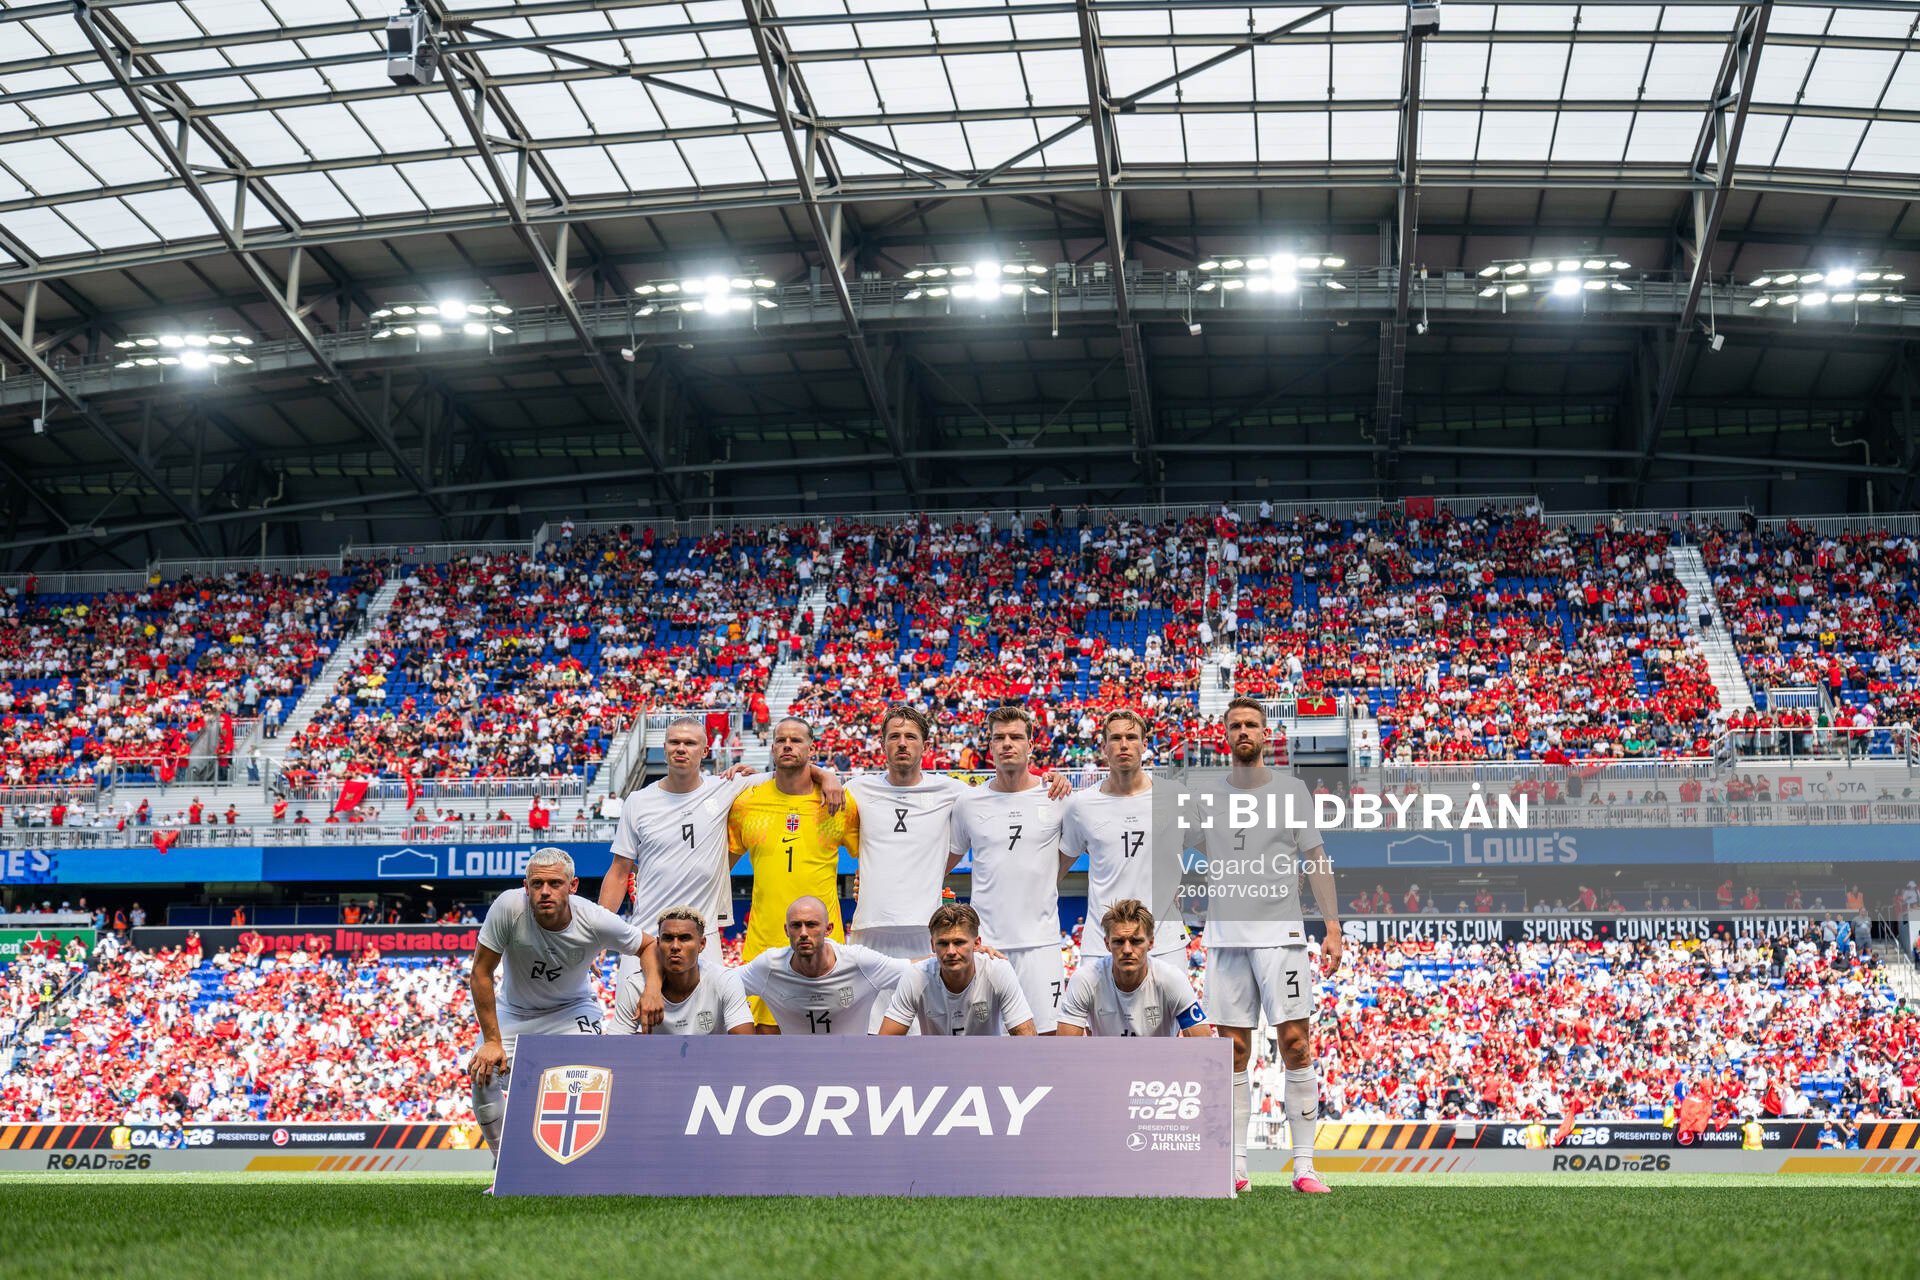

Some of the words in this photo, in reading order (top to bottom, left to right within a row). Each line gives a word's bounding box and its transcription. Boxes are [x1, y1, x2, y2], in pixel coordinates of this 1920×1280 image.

[1808, 782, 1867, 793] TOOTA
[893, 808, 908, 832] 8
[682, 823, 695, 849] 9
[1008, 824, 1023, 850] 7
[1121, 831, 1145, 858] 17
[0, 850, 50, 880] ES
[448, 846, 537, 876] LOWE'
[785, 846, 793, 872] 1
[335, 929, 477, 950] Illustrated
[1523, 918, 1593, 941] SPORTS
[1616, 917, 1710, 940] CONCERTS
[0, 943, 20, 954] en
[530, 960, 563, 982] 26
[1050, 981, 1062, 1008] 7
[1285, 970, 1300, 998] 3
[805, 1010, 832, 1033] 14
[1189, 1004, 1203, 1022] C
[566, 1070, 589, 1078] NORGE
[1128, 1081, 1201, 1097] ROAD
[684, 1084, 1053, 1136] NORWAY
[1128, 1106, 1155, 1119] TO
[217, 1133, 259, 1141] PRESENTED
[260, 1133, 270, 1141] BY
[291, 1132, 327, 1142] TURKISH
[328, 1132, 366, 1142] AIRLINES
[1151, 1133, 1201, 1142] TURKISH
[1151, 1142, 1201, 1151] AIRLINES
[1614, 1131, 1660, 1140] PRESENTED
[1662, 1131, 1673, 1140] BY
[1697, 1132, 1738, 1141] TURKISH
[47, 1154, 107, 1170] ROAD
[1552, 1154, 1621, 1171] ROAD
